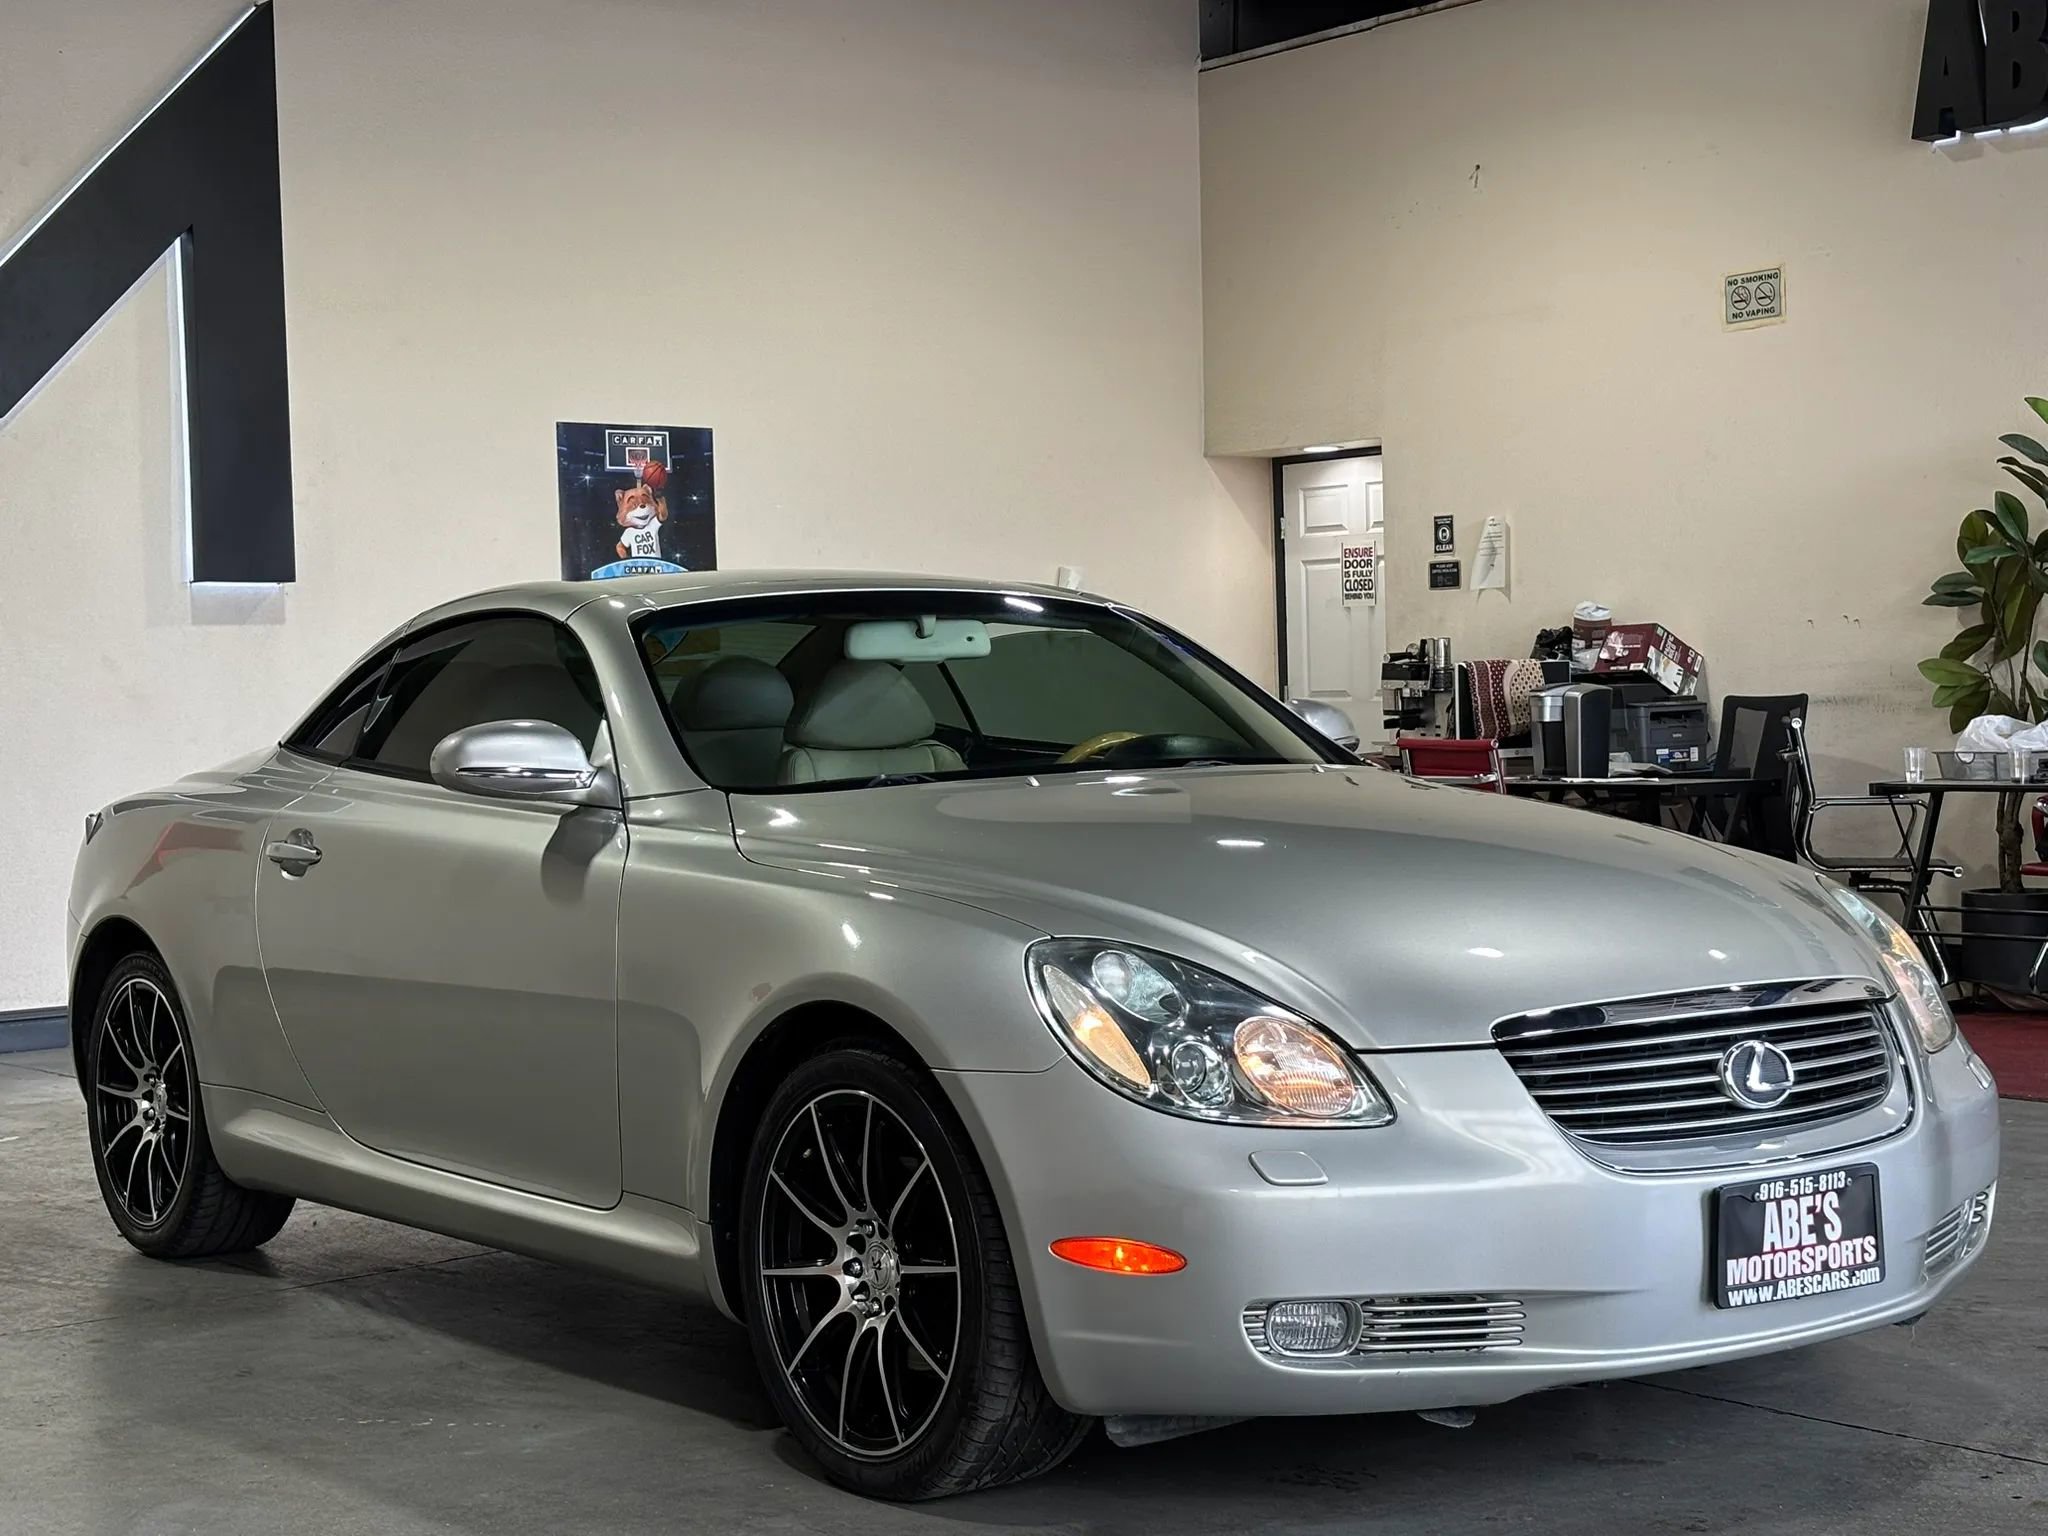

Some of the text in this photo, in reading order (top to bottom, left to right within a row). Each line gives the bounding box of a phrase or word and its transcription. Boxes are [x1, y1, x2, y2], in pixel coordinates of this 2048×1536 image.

[1740, 272, 1778, 284] SMOKING
[1745, 306, 1775, 317] VAPING
[612, 434, 663, 446] CARFAX
[634, 531, 654, 544] CAR
[636, 542, 655, 555] FOX
[1344, 547, 1373, 558] ENSURE
[1344, 559, 1373, 569] DOOR
[1344, 570, 1373, 578] IS FULLY
[1344, 579, 1373, 591] CLOSED
[1345, 592, 1374, 600] BEHIND YOU
[1759, 1171, 1846, 1201] 916-515-8113
[1763, 1191, 1843, 1252] ABE'S
[1726, 1236, 1877, 1286] MOTORSPORTS
